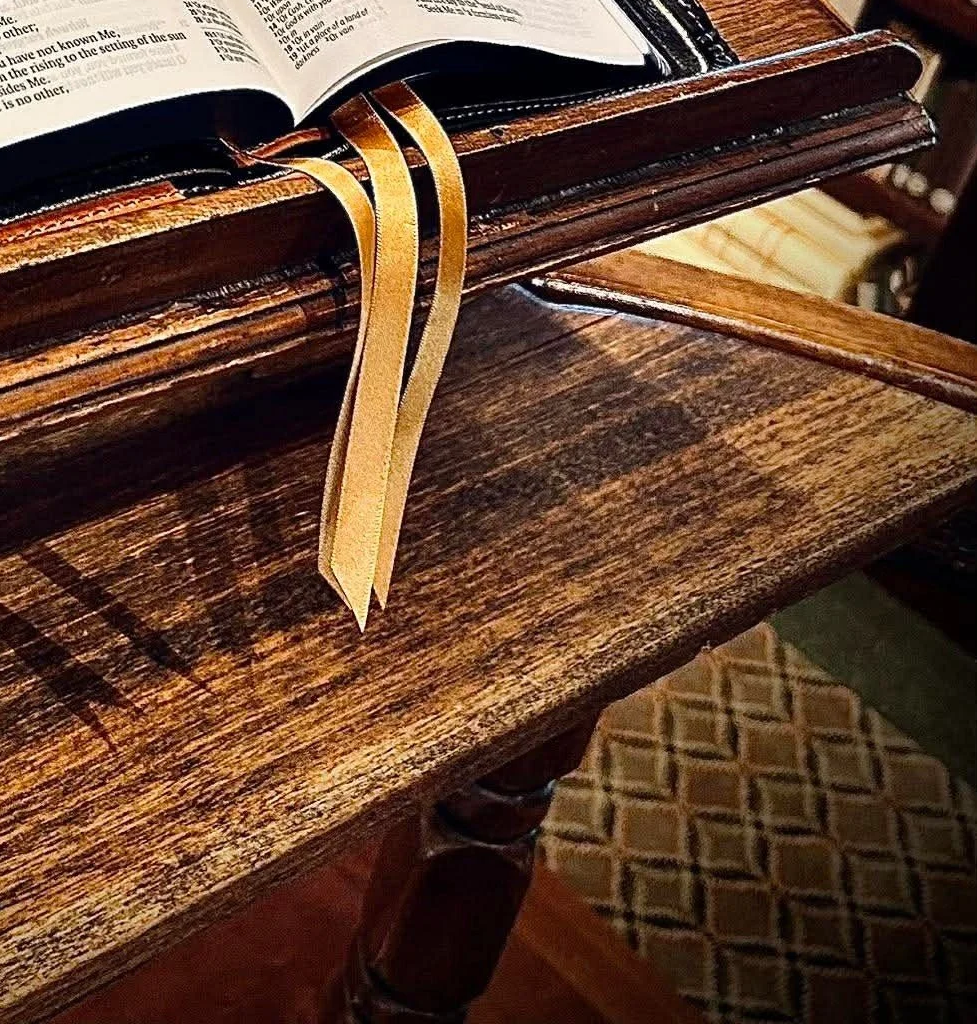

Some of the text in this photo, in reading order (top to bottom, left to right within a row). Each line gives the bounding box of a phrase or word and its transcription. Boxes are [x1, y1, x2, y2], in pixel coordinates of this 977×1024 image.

[7, 67, 28, 79] the
[29, 57, 65, 74] rising
[77, 47, 98, 59] the
[98, 39, 138, 54] setting
[147, 33, 167, 43] the
[166, 32, 187, 41] sun
